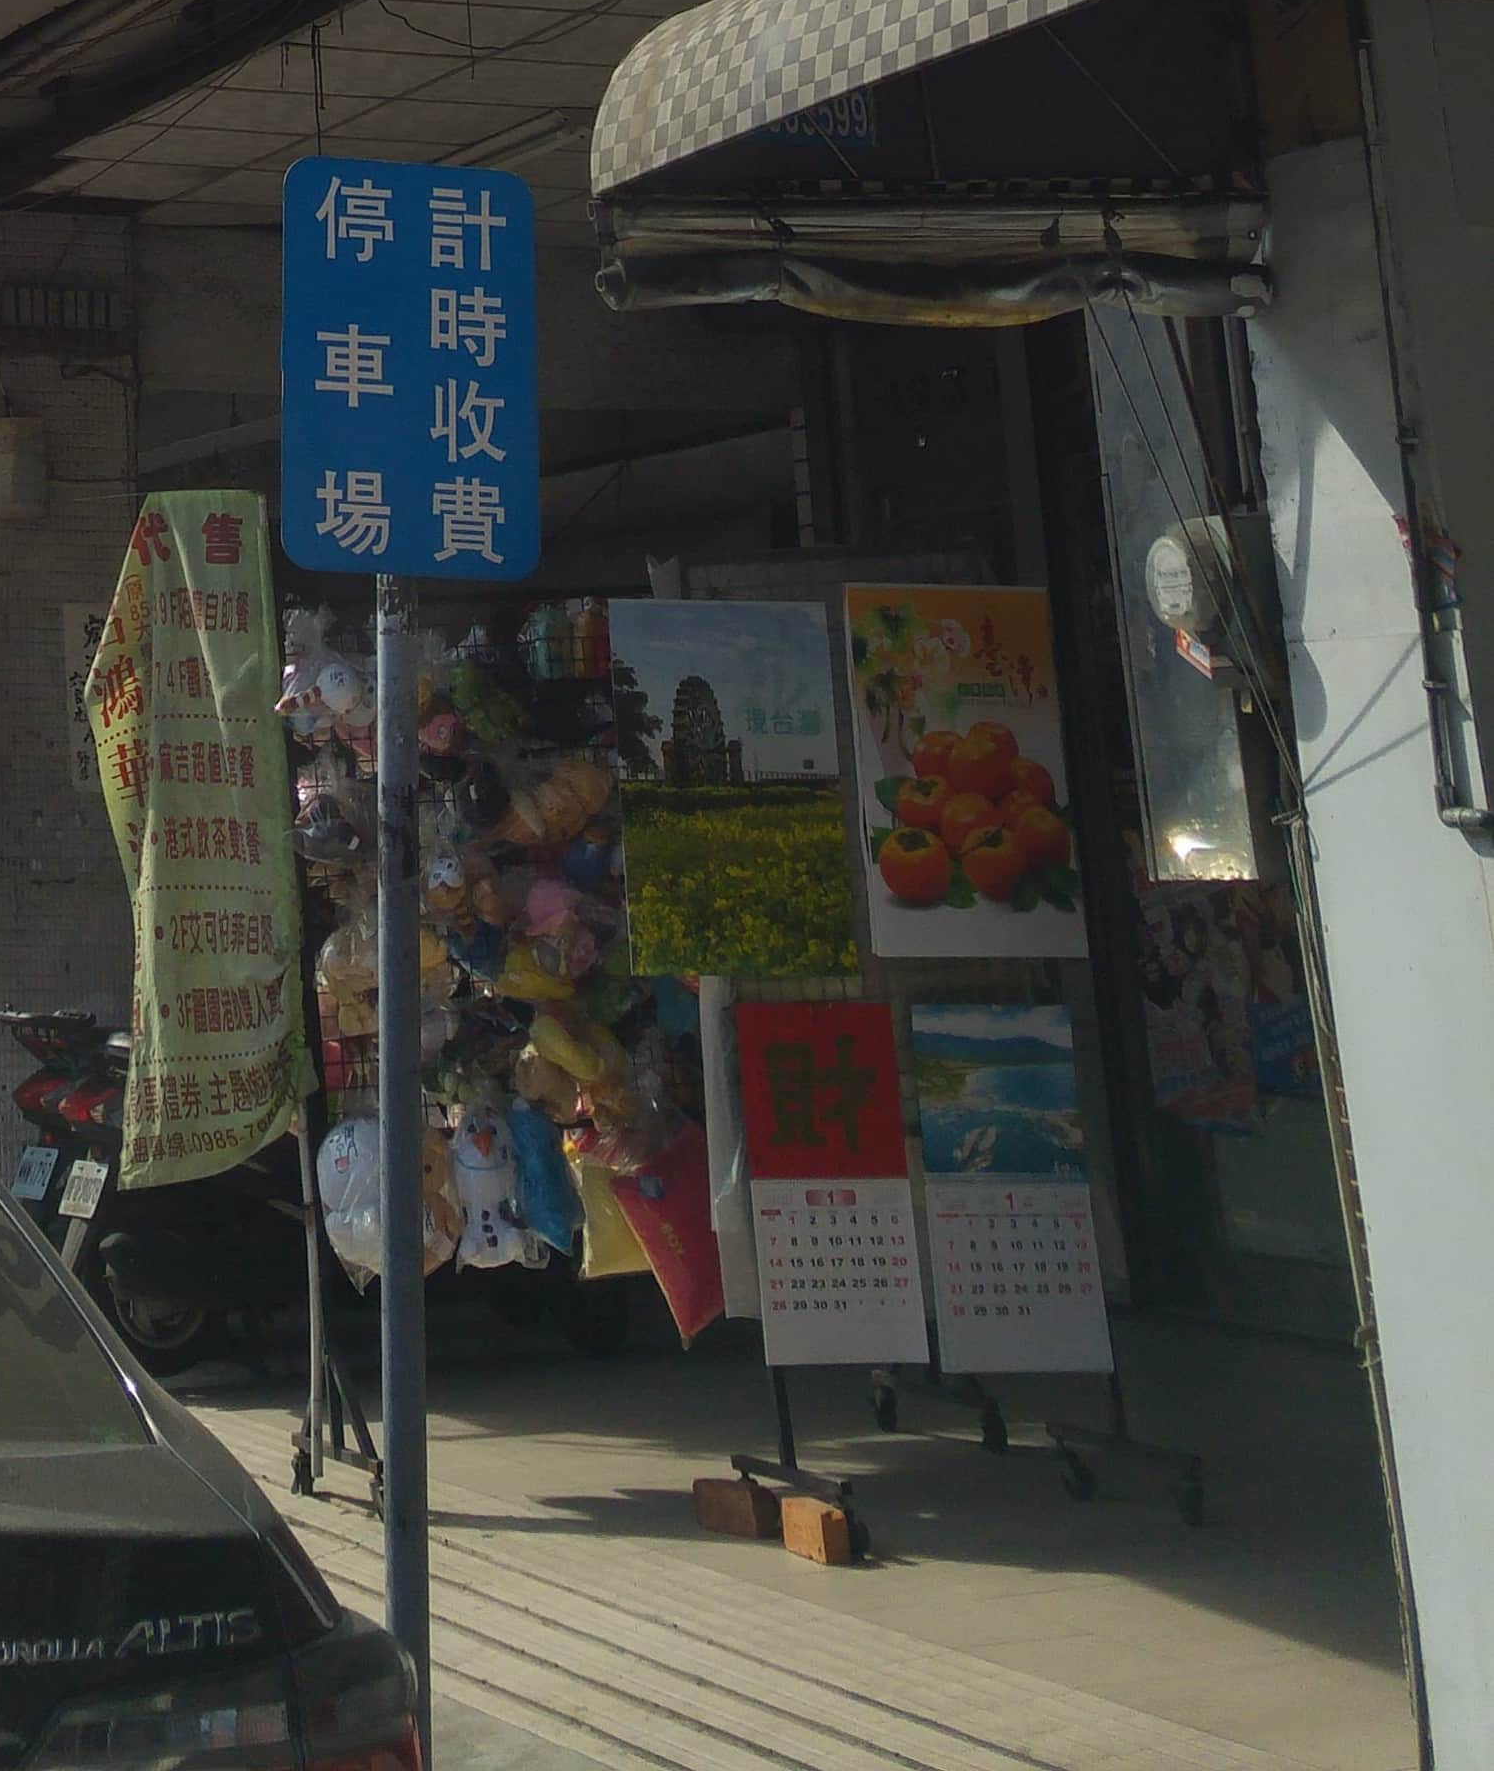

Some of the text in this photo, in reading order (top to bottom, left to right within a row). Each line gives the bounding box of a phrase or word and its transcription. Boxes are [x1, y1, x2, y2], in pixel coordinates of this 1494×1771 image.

[314, 175, 395, 557] 停車場
[428, 187, 507, 566] 計時收費
[132, 511, 244, 565] 代售
[768, 1037, 878, 1156] 財
[116, 1607, 264, 1658] ALTIS
